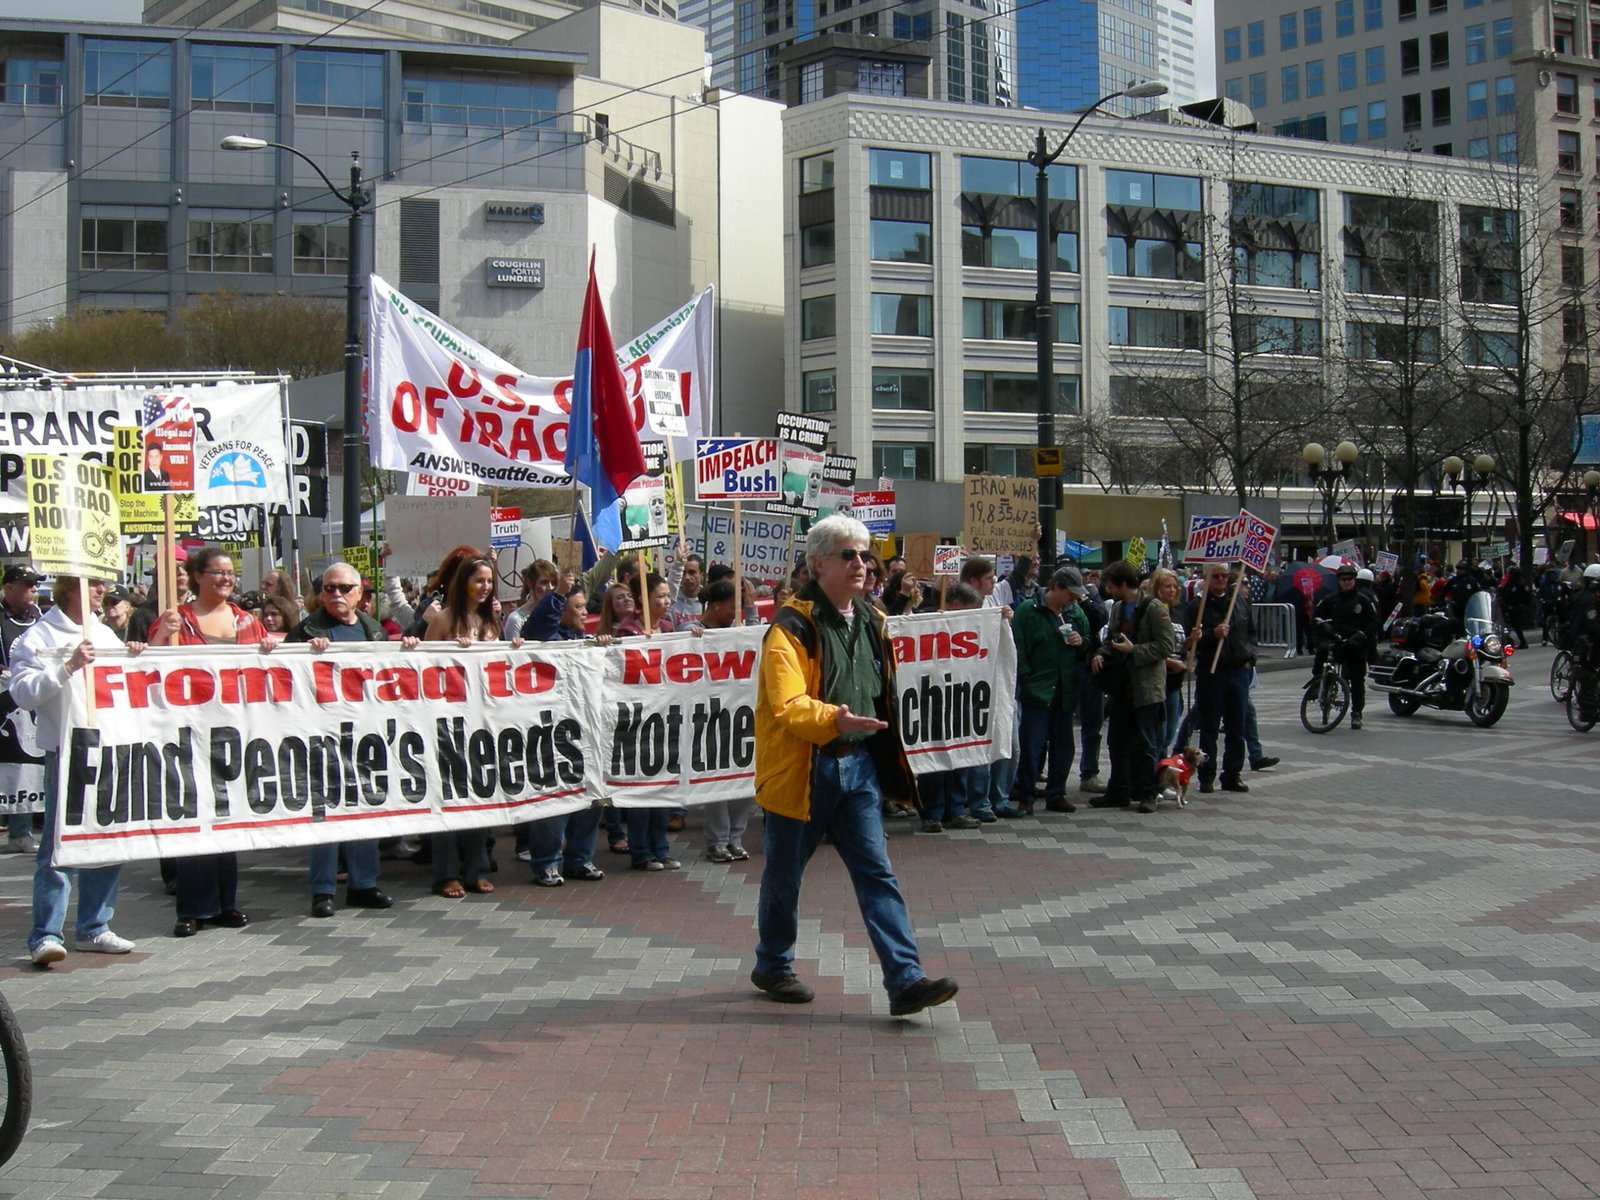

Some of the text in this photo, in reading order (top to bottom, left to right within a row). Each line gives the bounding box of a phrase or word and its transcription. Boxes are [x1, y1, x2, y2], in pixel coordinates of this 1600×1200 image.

[488, 206, 543, 216] MARCHEX
[492, 260, 541, 269] COUGHLIN
[511, 268, 541, 276] PORTER
[497, 274, 541, 283] LUNDEEN
[665, 371, 677, 382] THE
[446, 360, 542, 417] U.S.
[391, 380, 450, 436] OF
[776, 413, 831, 433] OCCUPATION
[155, 428, 193, 439] Illegal and
[779, 427, 825, 446] IS A CRIME
[162, 442, 192, 451] Immoral
[118, 452, 142, 472] OF
[169, 455, 189, 465] WAR!
[198, 439, 275, 471] VETERANS FOR PEACE
[699, 439, 777, 485] IMPEACH
[825, 456, 858, 469] PATION
[409, 451, 574, 487] ANSWERseattle.org
[823, 468, 852, 481] CRIME
[77, 464, 112, 490] OUT
[418, 475, 470, 491] BLOOD
[724, 469, 777, 493] Bush
[33, 482, 60, 505] OF
[970, 478, 1037, 501] IRAQ WAR
[120, 499, 134, 508] Stop
[34, 506, 82, 532] NOW
[120, 510, 159, 518] War Machine
[868, 507, 893, 519] Truth
[494, 523, 519, 535] Truth
[1188, 517, 1247, 550] IMPEACH
[35, 534, 52, 545] Stop
[971, 537, 1033, 552] SCHOLARSHIPS
[36, 546, 49, 556] War
[713, 540, 726, 556] &
[1204, 540, 1240, 558] Bush
[935, 550, 959, 565] IMPEACH
[942, 560, 959, 570] Bush
[84, 664, 293, 709] From
[312, 660, 467, 703] Iraq
[484, 660, 558, 697] to
[622, 648, 757, 686] New
[64, 725, 199, 827] Fund
[209, 718, 426, 823] People's
[436, 708, 585, 801] Needs
[611, 700, 682, 777] Not
[690, 697, 756, 773] the
